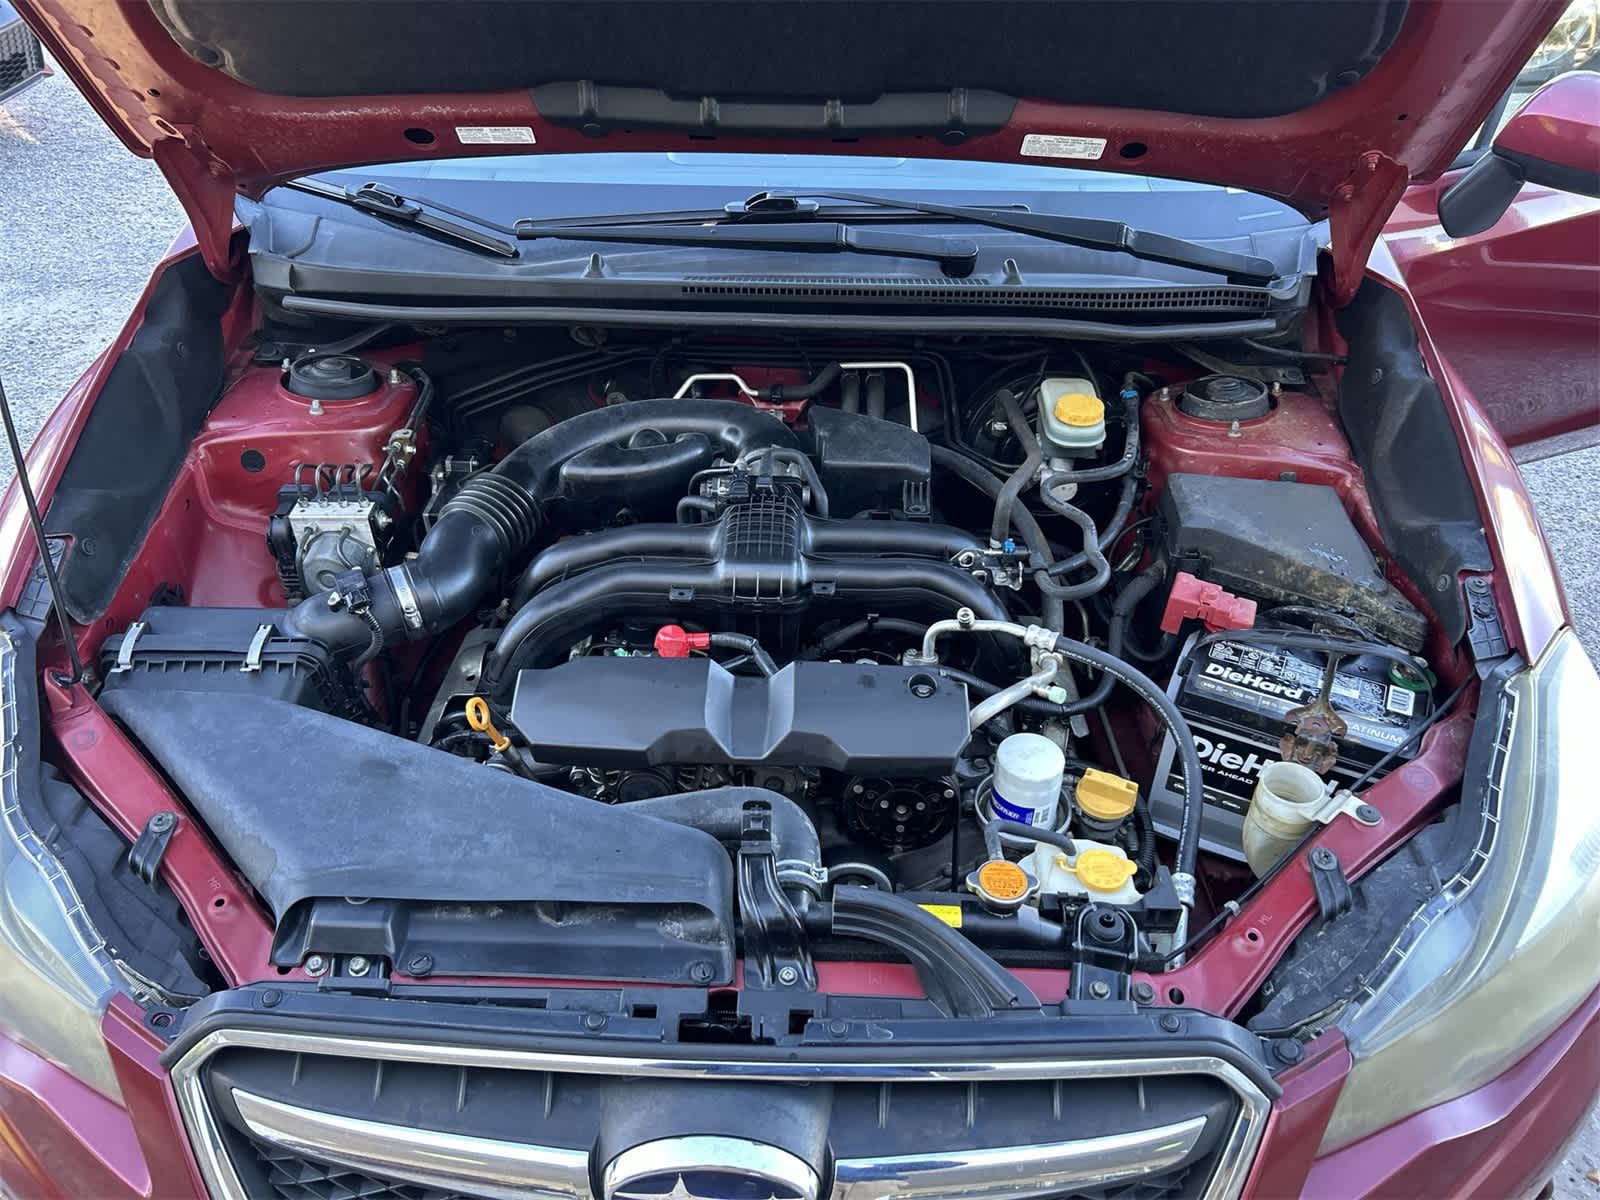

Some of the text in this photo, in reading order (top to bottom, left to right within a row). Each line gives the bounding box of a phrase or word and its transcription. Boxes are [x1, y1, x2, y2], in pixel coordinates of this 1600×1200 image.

[1205, 662, 1304, 700] DieHard
[1347, 722, 1404, 744] ATINUM
[1217, 770, 1255, 785] AHEAD
